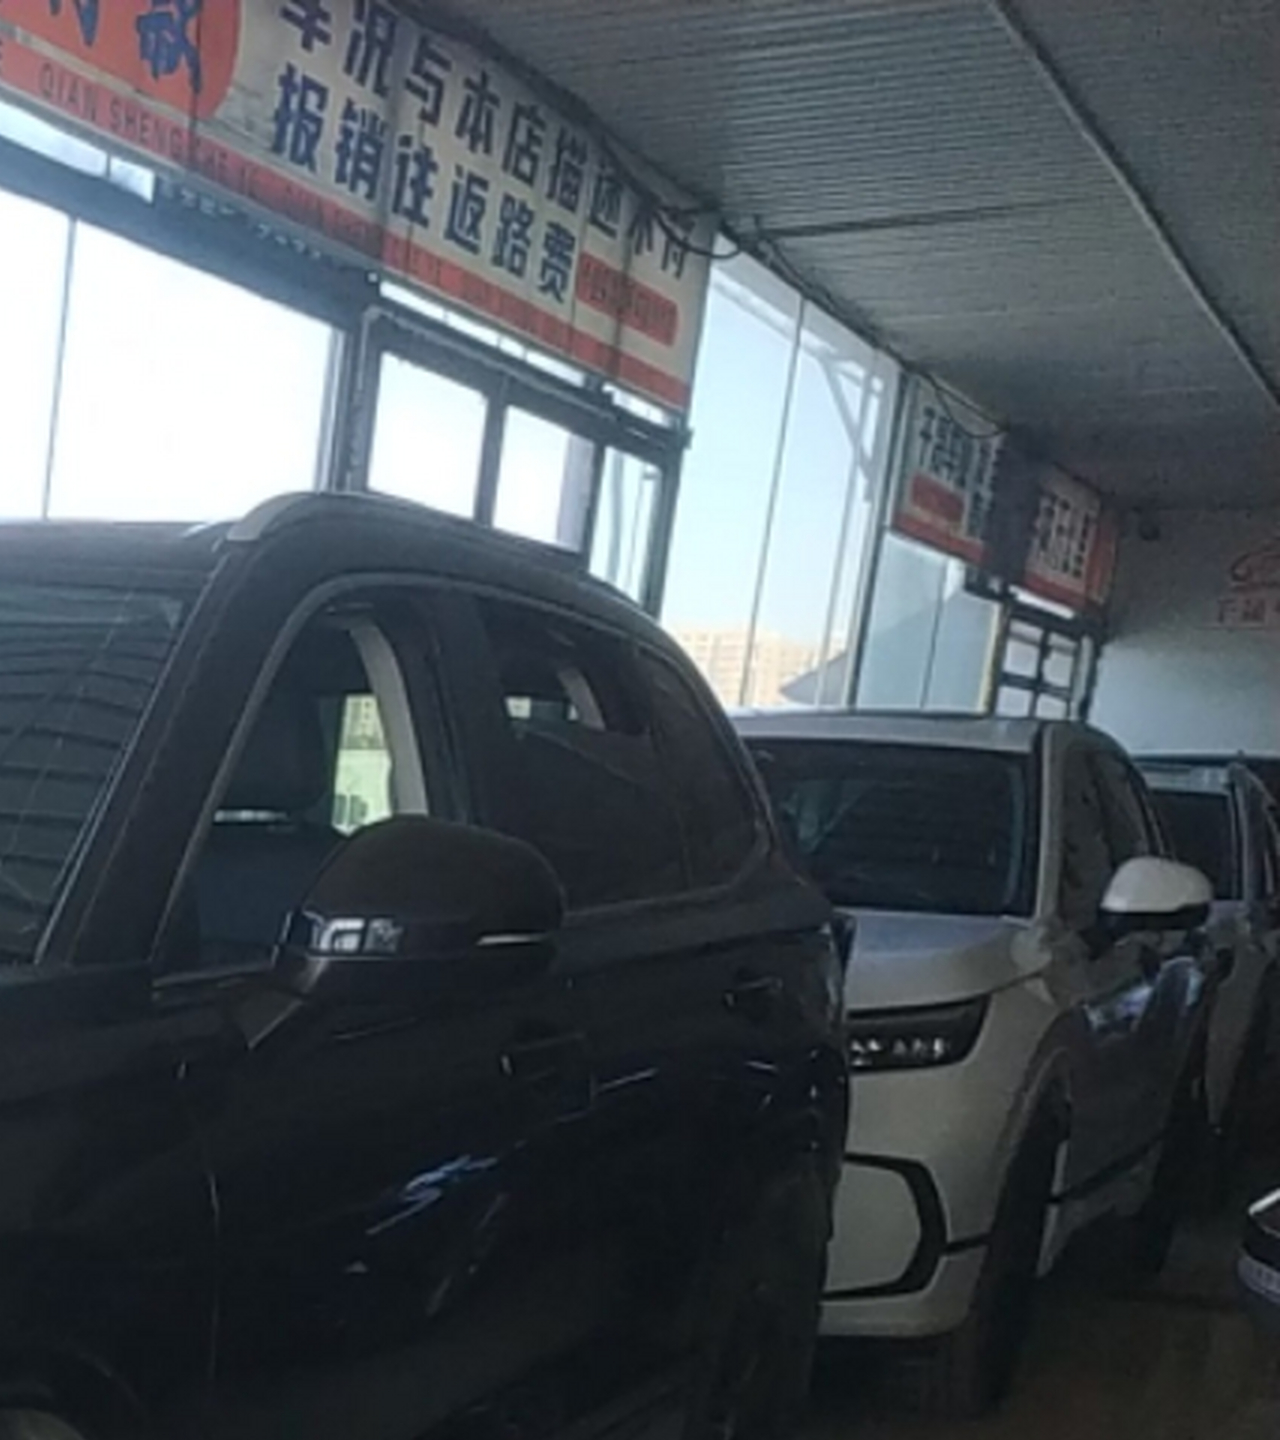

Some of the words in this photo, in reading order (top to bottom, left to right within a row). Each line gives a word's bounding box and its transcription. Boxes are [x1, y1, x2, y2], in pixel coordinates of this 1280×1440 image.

[272, 61, 577, 305] 报销往返路费
